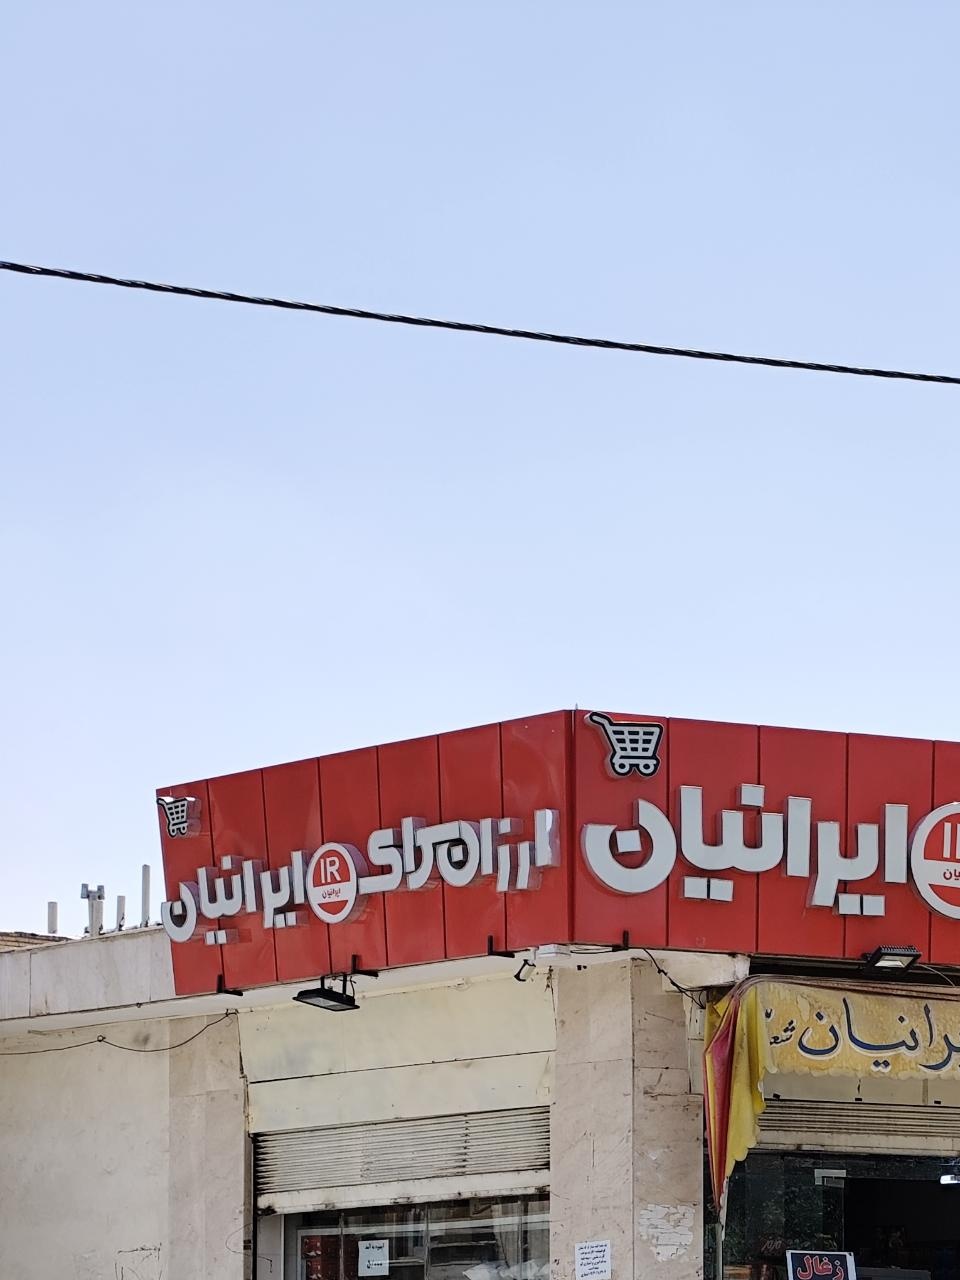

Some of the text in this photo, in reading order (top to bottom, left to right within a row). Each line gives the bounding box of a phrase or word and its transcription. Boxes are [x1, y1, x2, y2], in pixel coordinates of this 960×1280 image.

[160, 849, 309, 946] ایرانیان
[319, 856, 342, 884] IR
[581, 782, 908, 917] ایرانیان
